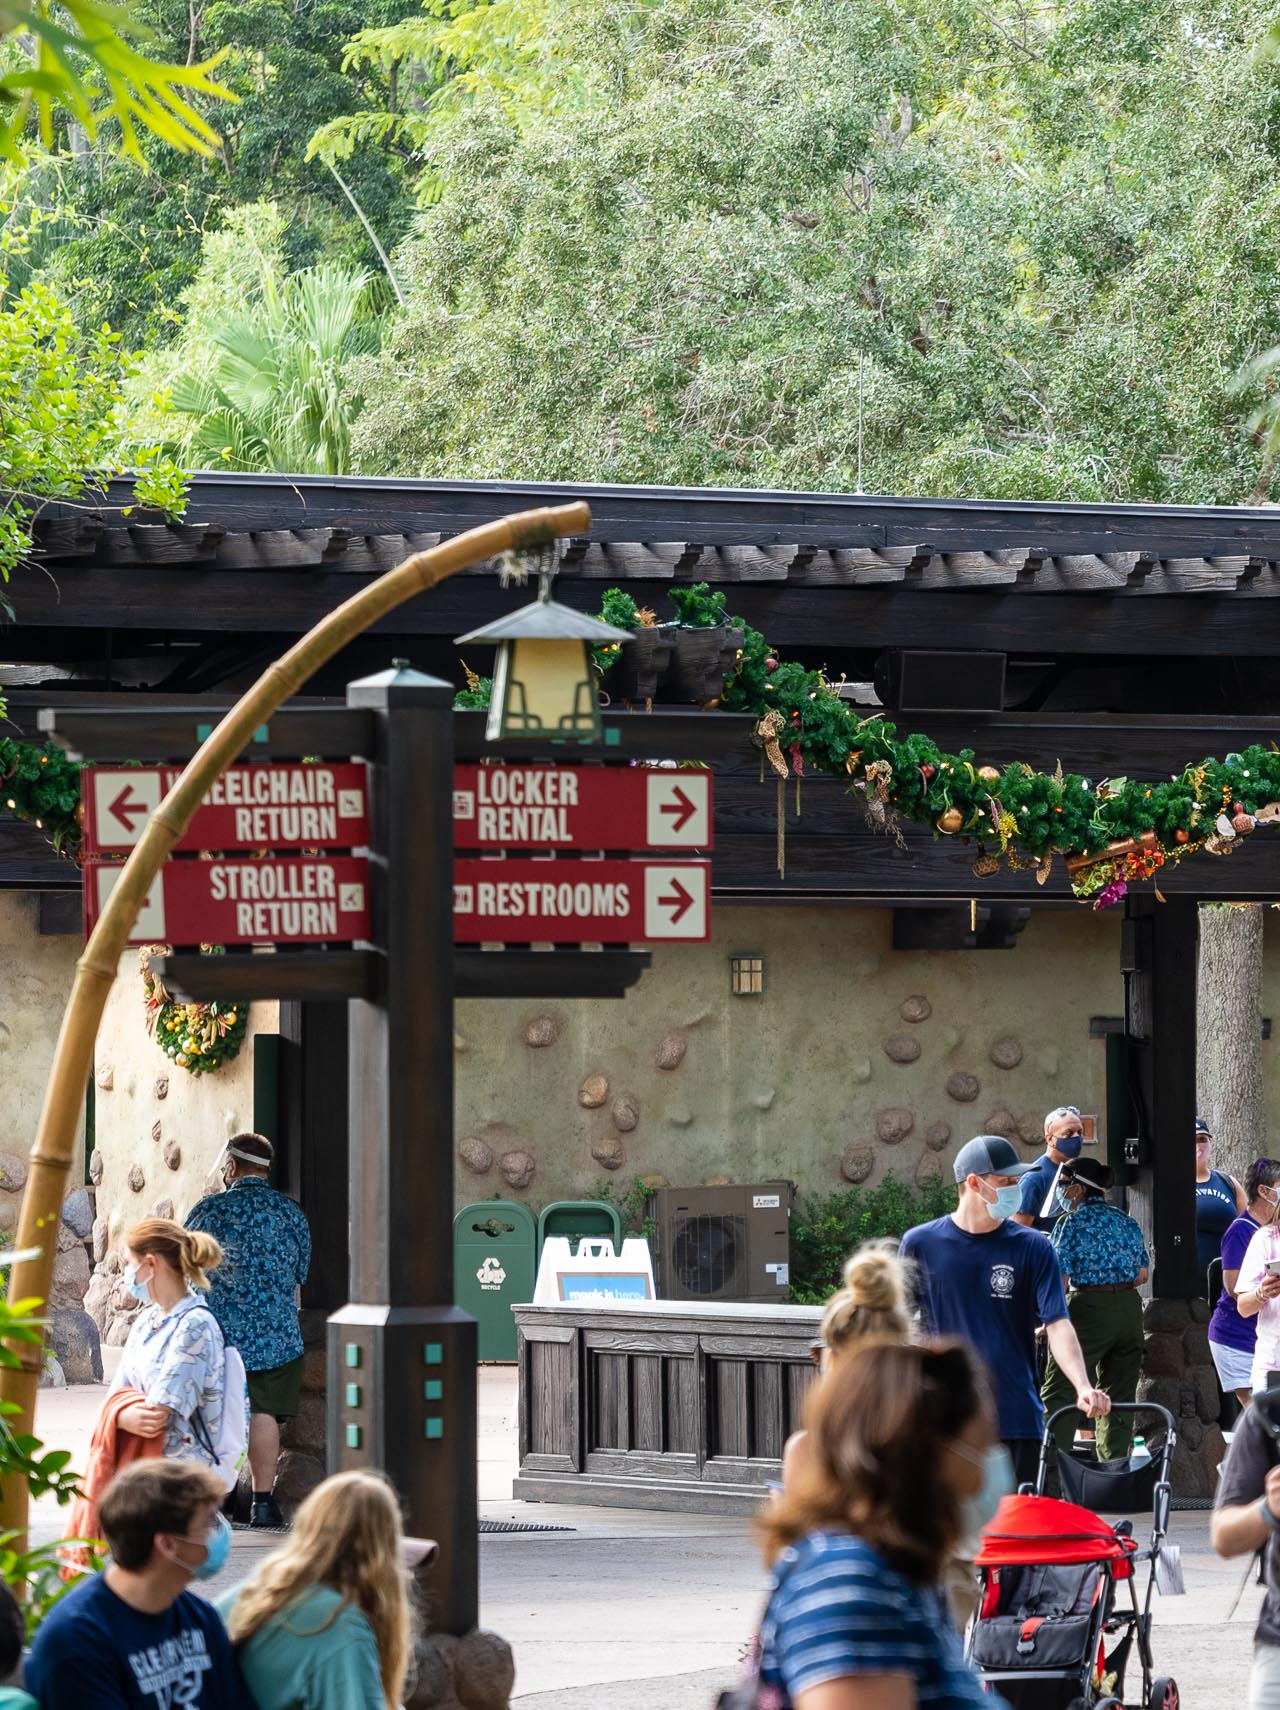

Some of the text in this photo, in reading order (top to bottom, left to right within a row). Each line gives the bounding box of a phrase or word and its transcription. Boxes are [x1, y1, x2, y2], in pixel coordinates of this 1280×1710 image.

[166, 769, 336, 805] EELCHAIR
[477, 770, 579, 806] LOCKER
[235, 806, 337, 842] RETURN
[477, 806, 574, 842] RENTAL
[209, 864, 337, 900] STROLLER
[477, 882, 630, 917] RESTROOMS
[236, 901, 338, 936] RETURN
